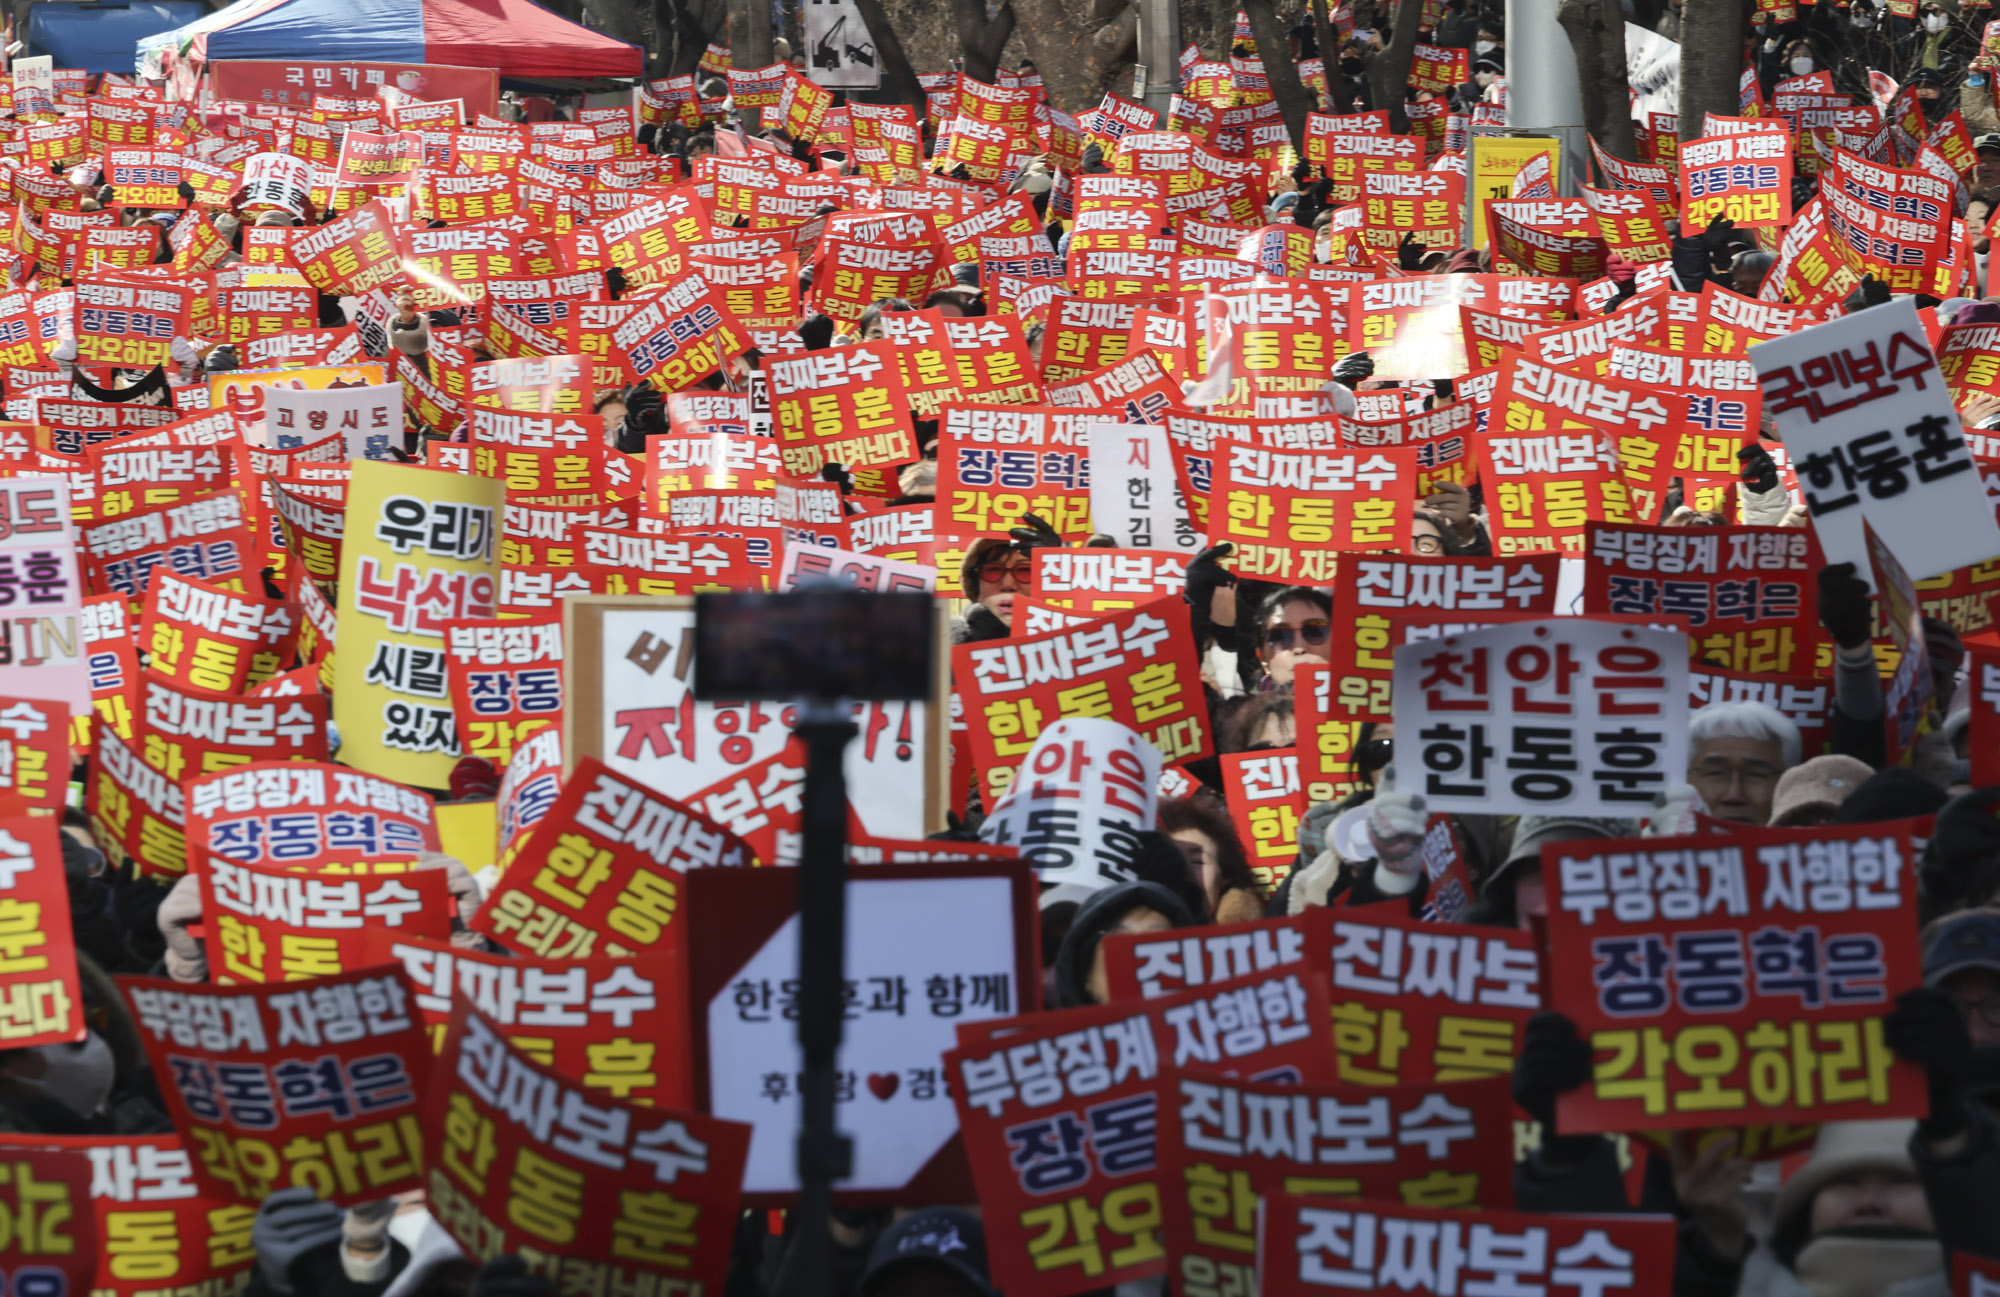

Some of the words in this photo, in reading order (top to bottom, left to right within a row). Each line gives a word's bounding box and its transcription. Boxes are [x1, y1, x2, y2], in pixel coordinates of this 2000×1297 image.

[285, 67, 385, 91] 국민카페
[962, 78, 1031, 102] 진짜보수
[25, 122, 82, 142] 진짜보수
[89, 102, 149, 125] 진짜보수
[398, 105, 454, 124] 진짜보수
[1801, 109, 1872, 130] 진짜보수
[110, 150, 150, 166] 부당징계
[456, 133, 524, 153] 진짜보수
[544, 146, 583, 162] 부당징계
[1334, 136, 1416, 158] 진짜보수
[1683, 140, 1733, 168] 부당징계
[1736, 134, 1786, 160] 자행한
[114, 167, 180, 185] 장동혁은
[436, 174, 509, 195] 진짜보수
[519, 159, 583, 190] 진짜보수
[717, 164, 780, 191] 진짜보수
[1081, 176, 1158, 200] 진짜보수
[1366, 173, 1447, 196] 진짜보수
[1624, 165, 1668, 183] 자행한
[1689, 165, 1779, 198] 장동혁은
[1837, 153, 1896, 192] 부당징계
[1900, 173, 1949, 203] 자행한
[112, 186, 180, 206] 각오하라
[884, 187, 953, 210] 진짜보수
[1687, 193, 1781, 228] 각오하라
[1821, 181, 1879, 231] 부당징계
[1881, 215, 1937, 246] 자행한
[1844, 180, 1940, 222] 장동혁은
[48, 213, 115, 231] 진짜보수
[88, 228, 152, 247] 진짜보수
[290, 208, 377, 264] 진짜보수
[602, 194, 689, 243] 진짜보수
[943, 199, 1024, 246] 진짜보수
[1366, 229, 1398, 249] 우리가
[1501, 213, 1597, 254] 진짜보수
[411, 230, 510, 254] 진짜보수
[838, 243, 934, 272] 진짜보수
[980, 236, 1030, 258] 부당징계
[77, 281, 134, 308] 부당징계
[136, 289, 181, 315] 자행한
[231, 290, 311, 313] 진짜보수
[488, 278, 551, 302] 부당징계
[553, 271, 603, 298] 자행한
[1363, 278, 1485, 311] 진짜보수
[81, 309, 174, 338] 장동혁은
[613, 307, 664, 352] 부당징계
[660, 273, 709, 315] 자행한
[77, 335, 170, 367] 각오하라
[630, 303, 721, 375] 장동혁은
[1539, 304, 1660, 366] 진짜보수
[471, 360, 581, 391] 진짜보수
[772, 348, 883, 395] 진짜보수
[1608, 345, 1683, 387] 부당징계
[1688, 357, 1757, 391] 자행한
[1759, 331, 1936, 424] 국민보수
[42, 402, 118, 428] 부당징계
[675, 392, 749, 422] 부당징계
[1512, 358, 1669, 431] 진짜보수
[473, 409, 589, 450] 진짜보수
[946, 408, 1046, 447] 부당징계
[1407, 402, 1473, 442] 자행한
[101, 448, 222, 488] 진짜보수
[658, 437, 783, 475] 진짜보수
[823, 430, 912, 468] 지켜낸다
[1229, 446, 1397, 492] 진짜보수
[1488, 434, 1618, 476] 진짜보수
[1795, 414, 1973, 518] 한동훈
[87, 512, 168, 560] 부당징계
[166, 495, 242, 541] 자행한
[376, 494, 495, 565] 우리가
[720, 495, 781, 528] 자행한
[585, 530, 730, 577] 진짜보수
[1593, 529, 1719, 574] 부당징계
[1728, 532, 1808, 571] 자행한
[1041, 551, 1187, 595] 진짜보수
[1357, 562, 1544, 611] 진짜보수
[156, 574, 292, 645] 진짜보수
[1608, 574, 1801, 627] 장동혁은
[449, 622, 563, 665] 부당징계
[972, 612, 1171, 695] 진짜보수
[366, 640, 449, 698] 시킬
[1420, 643, 1662, 717] 천안은
[145, 683, 317, 748] 진짜보수
[1420, 722, 1665, 802] 한동훈
[193, 768, 326, 820] 부당징계
[333, 770, 432, 826] 자행한
[208, 813, 424, 866] 장동혁은
[207, 856, 422, 929] 진짜보수
[1559, 844, 1749, 925] 부당징계
[1759, 836, 1902, 913] 자행한
[392, 942, 656, 1028] 진짜보수
[1331, 920, 1541, 1010] 진짜보
[1591, 926, 1888, 1019] 장동혁은
[130, 984, 268, 1052] 부당징계
[268, 974, 411, 1048] 자행한
[925, 973, 1010, 1018] 함께
[959, 1013, 1159, 1119] 부당징계
[1165, 973, 1312, 1068] 자행한
[1591, 1017, 1895, 1117] 각오하라
[168, 1053, 415, 1130] 장동혁은
[457, 1012, 708, 1184] 진짜보수
[1180, 1079, 1476, 1166] 진짜보수
[1296, 1205, 1634, 1297] 진짜보수
